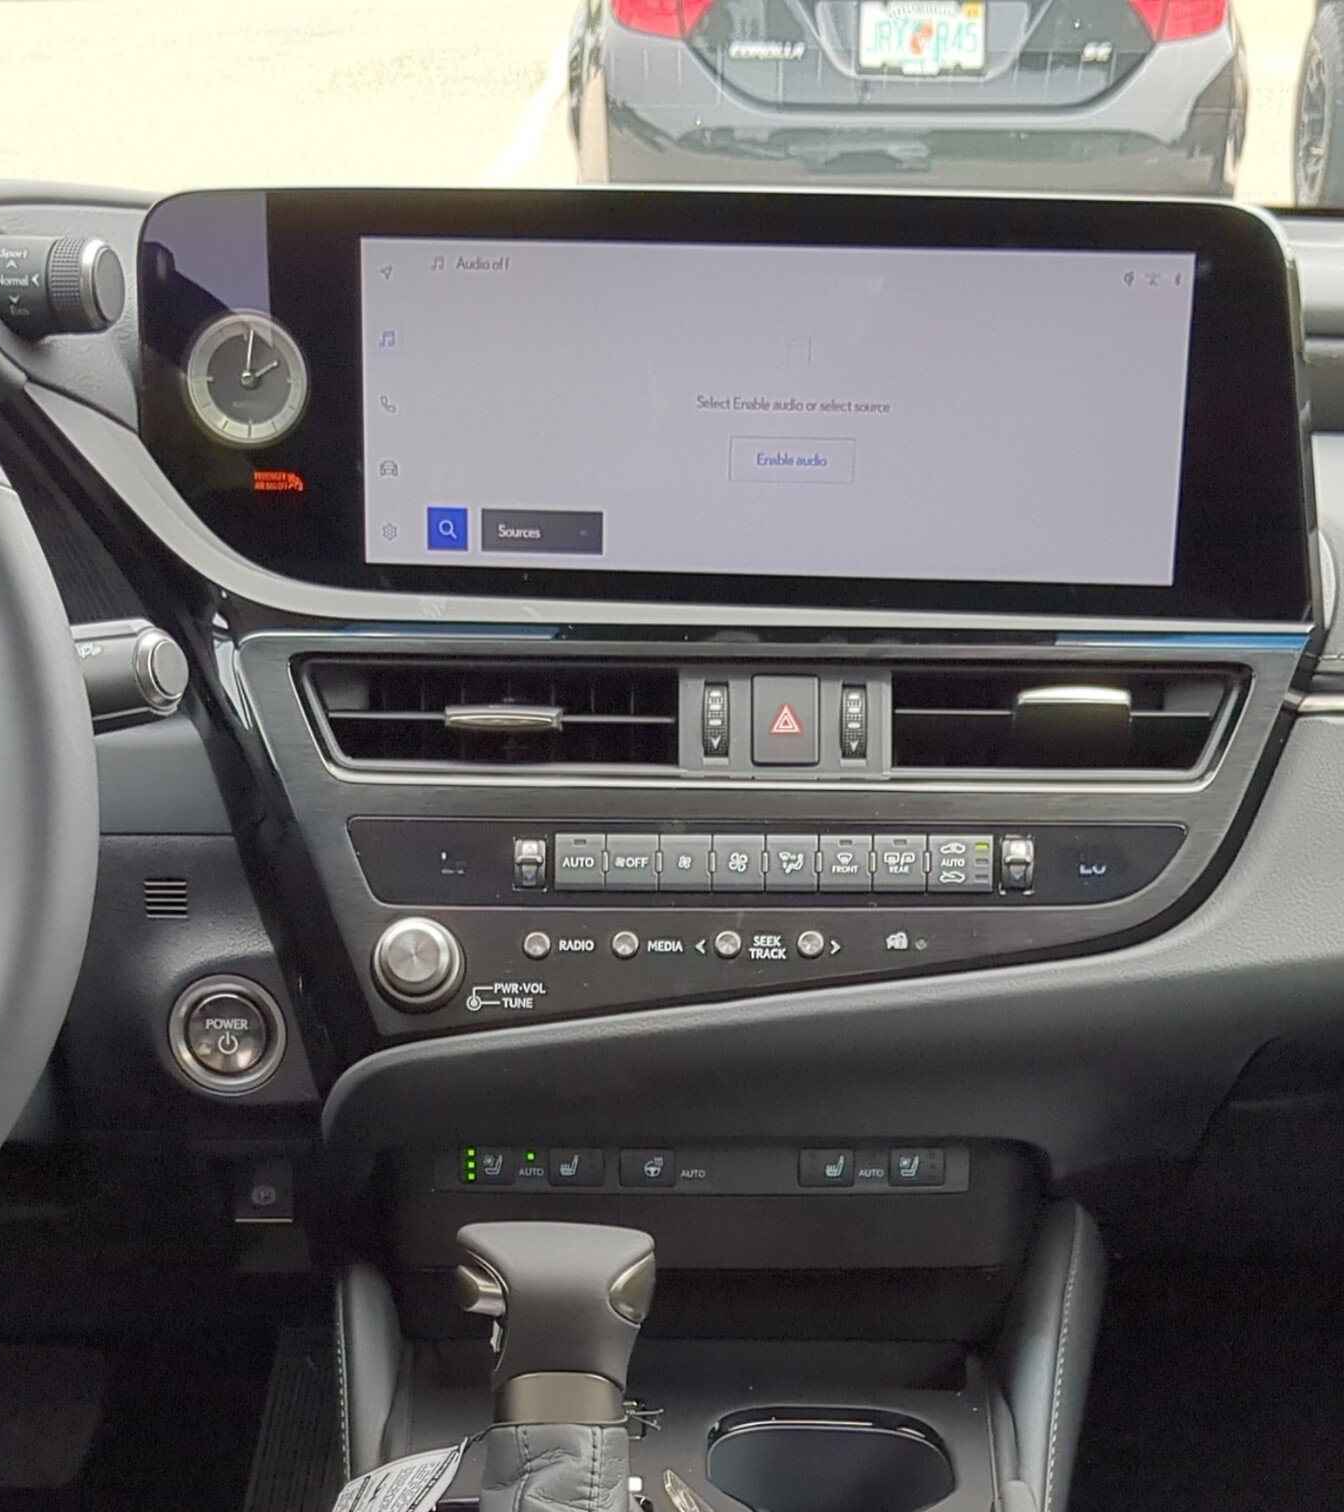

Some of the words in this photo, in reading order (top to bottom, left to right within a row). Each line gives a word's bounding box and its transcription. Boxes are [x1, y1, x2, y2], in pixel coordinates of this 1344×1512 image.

[0, 248, 27, 259] Sport
[456, 256, 490, 270] Audio
[697, 395, 731, 410] Select
[733, 397, 771, 411] Enable
[773, 399, 804, 412] audio
[805, 402, 817, 412] or
[819, 400, 852, 413] select
[854, 403, 891, 414] source
[757, 452, 795, 467] Enable
[796, 453, 828, 467] audio
[498, 524, 541, 539] Sources
[562, 856, 595, 868] AUTO
[626, 856, 649, 868] OFF
[941, 858, 965, 867] AUTO
[832, 865, 858, 873] FRONT
[559, 939, 595, 951] RADIO
[648, 940, 684, 952] MEDIA
[753, 936, 781, 947] SEEK
[748, 948, 787, 960] TRACK
[502, 997, 534, 1008] TUNE
[206, 1018, 249, 1030] POWER
[518, 1168, 544, 1176] AUTO
[680, 1169, 706, 1178] AUTO
[858, 1169, 884, 1178] AUTO
